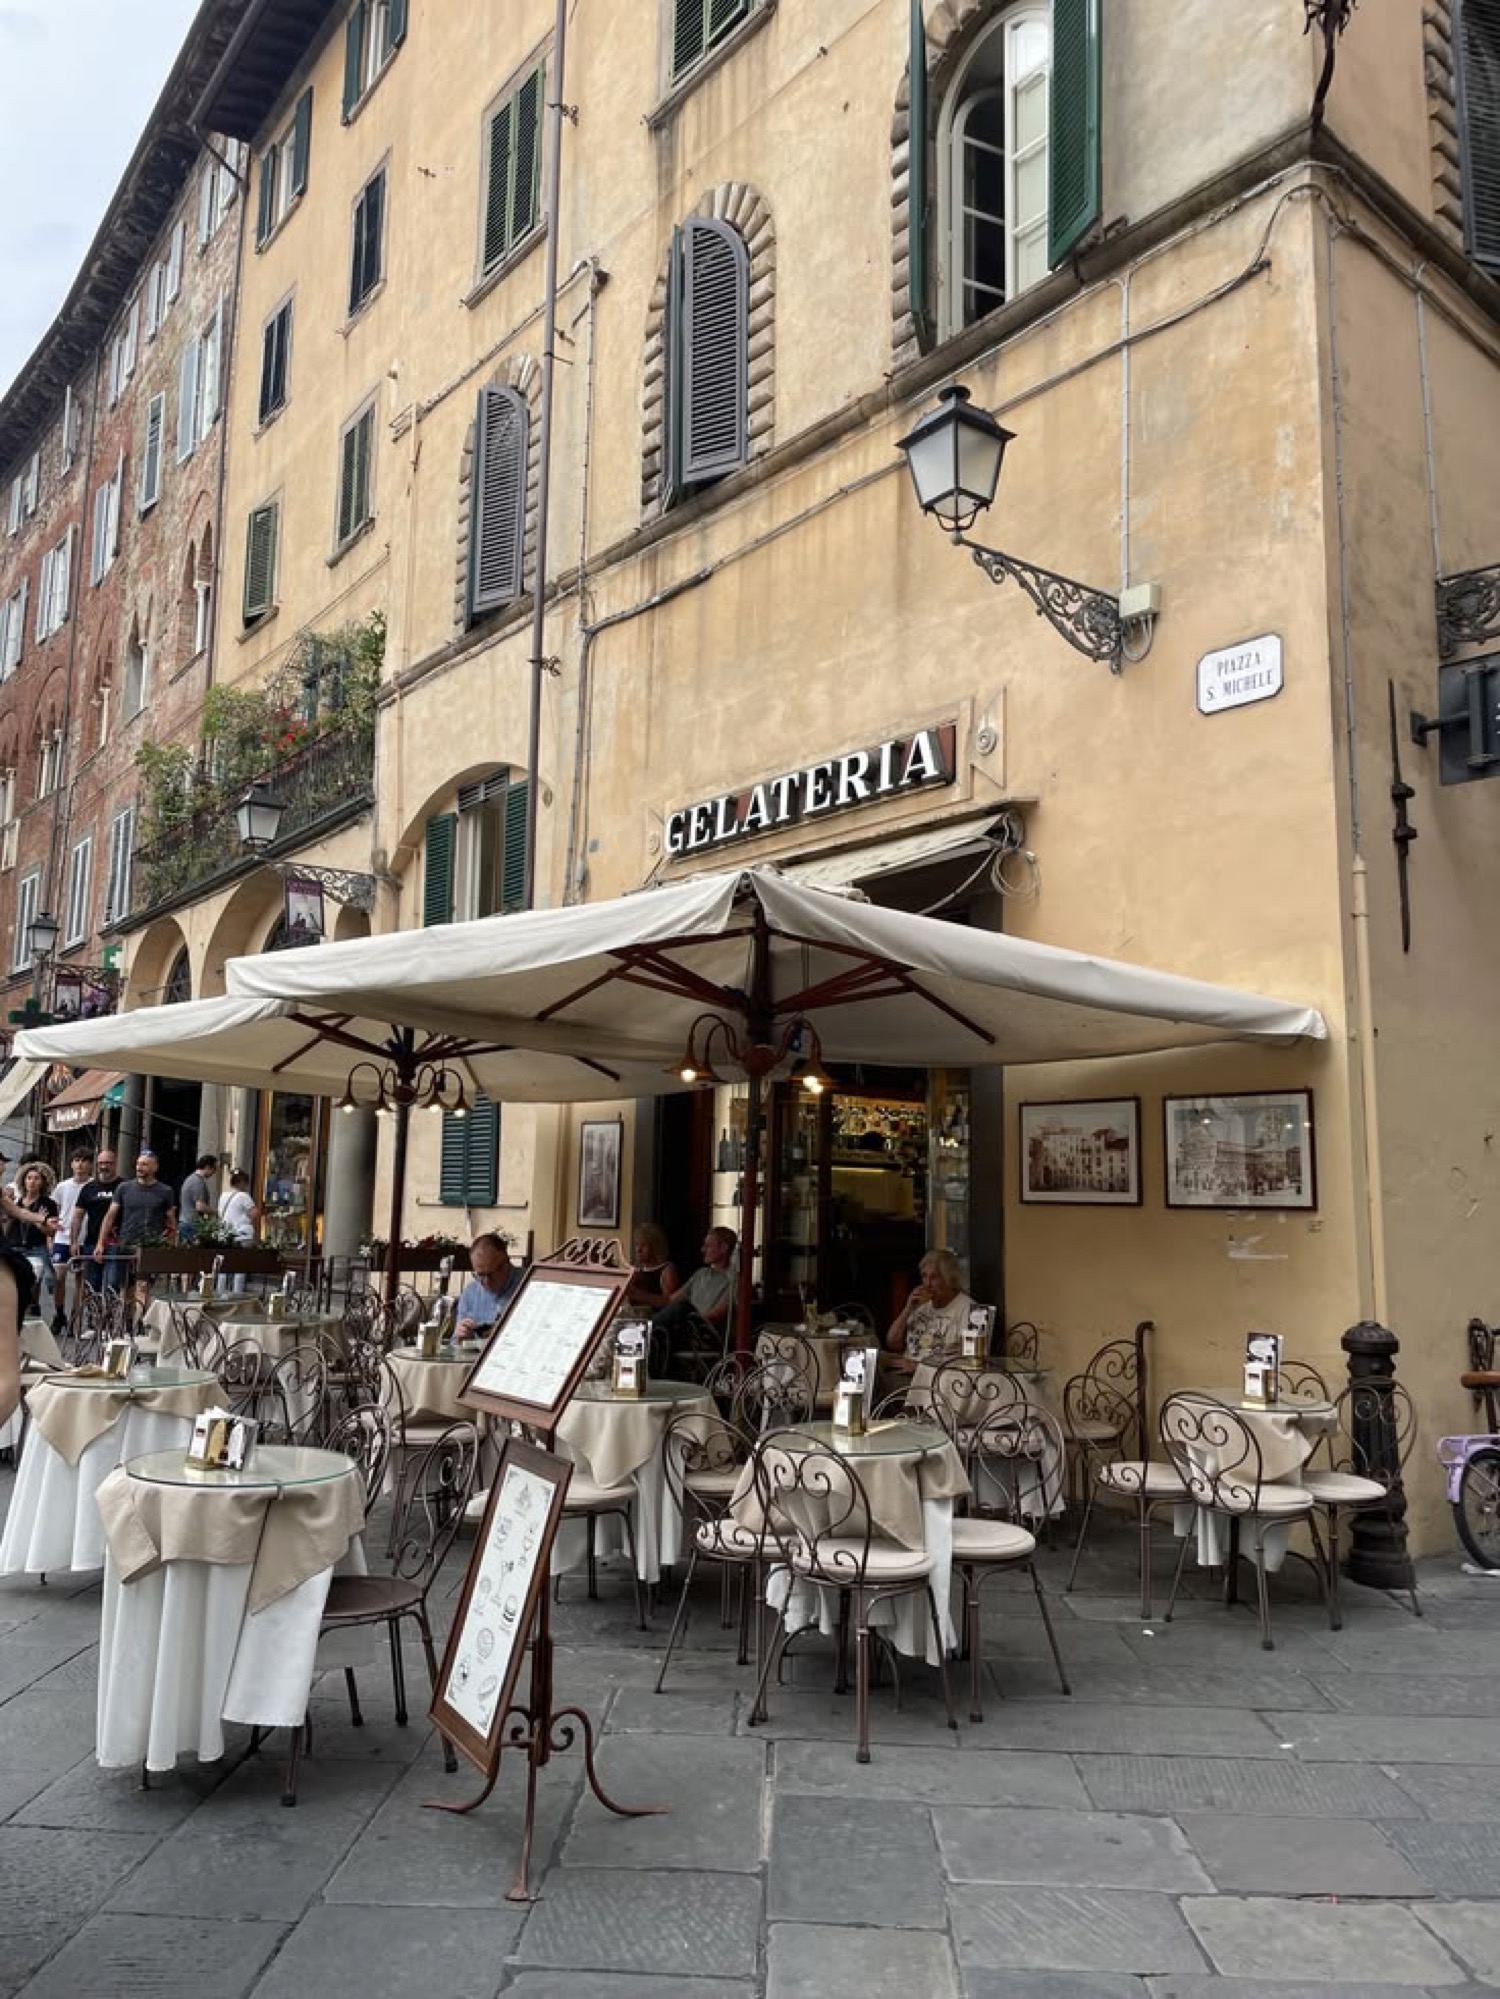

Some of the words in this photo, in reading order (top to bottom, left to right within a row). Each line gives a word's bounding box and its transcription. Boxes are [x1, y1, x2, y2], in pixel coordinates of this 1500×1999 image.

[1217, 652, 1260, 676] PIAZZA
[1222, 669, 1273, 696] MICHELE
[664, 729, 940, 854] GELATERIA
